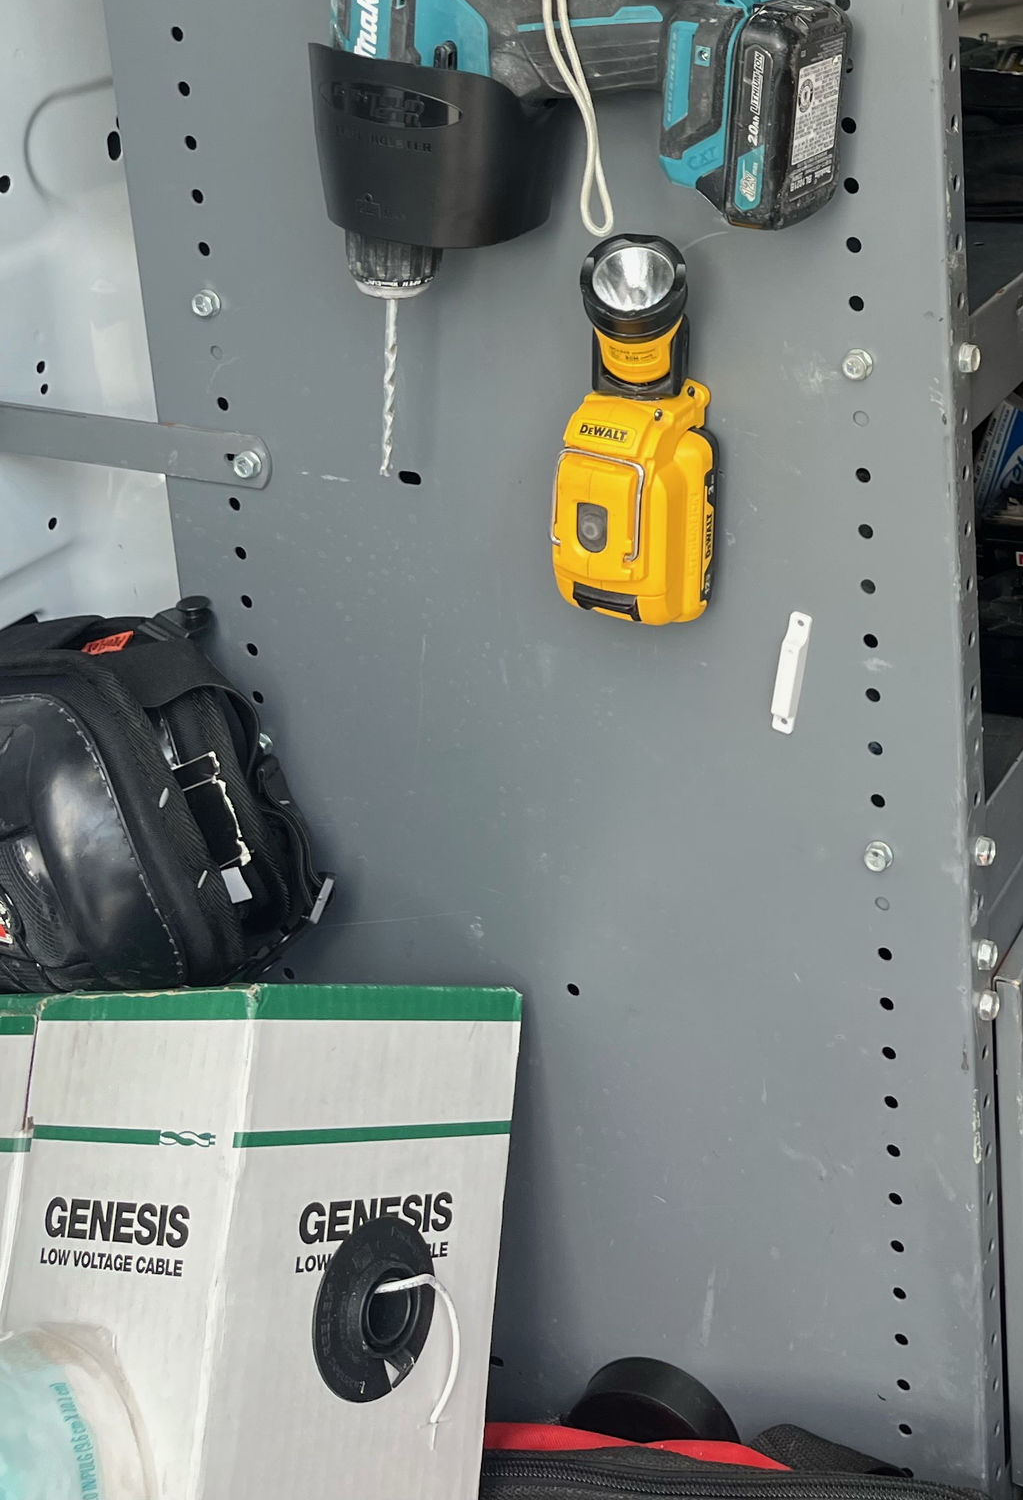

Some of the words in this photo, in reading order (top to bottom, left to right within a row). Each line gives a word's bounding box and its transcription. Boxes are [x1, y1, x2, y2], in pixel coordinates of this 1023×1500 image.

[750, 51, 765, 115] LITHIUM-ION
[45, 1196, 190, 1248] GENESIS
[40, 1247, 71, 1266] LOW
[73, 1250, 133, 1272] VOLTAGE
[136, 1256, 183, 1277] CABLE
